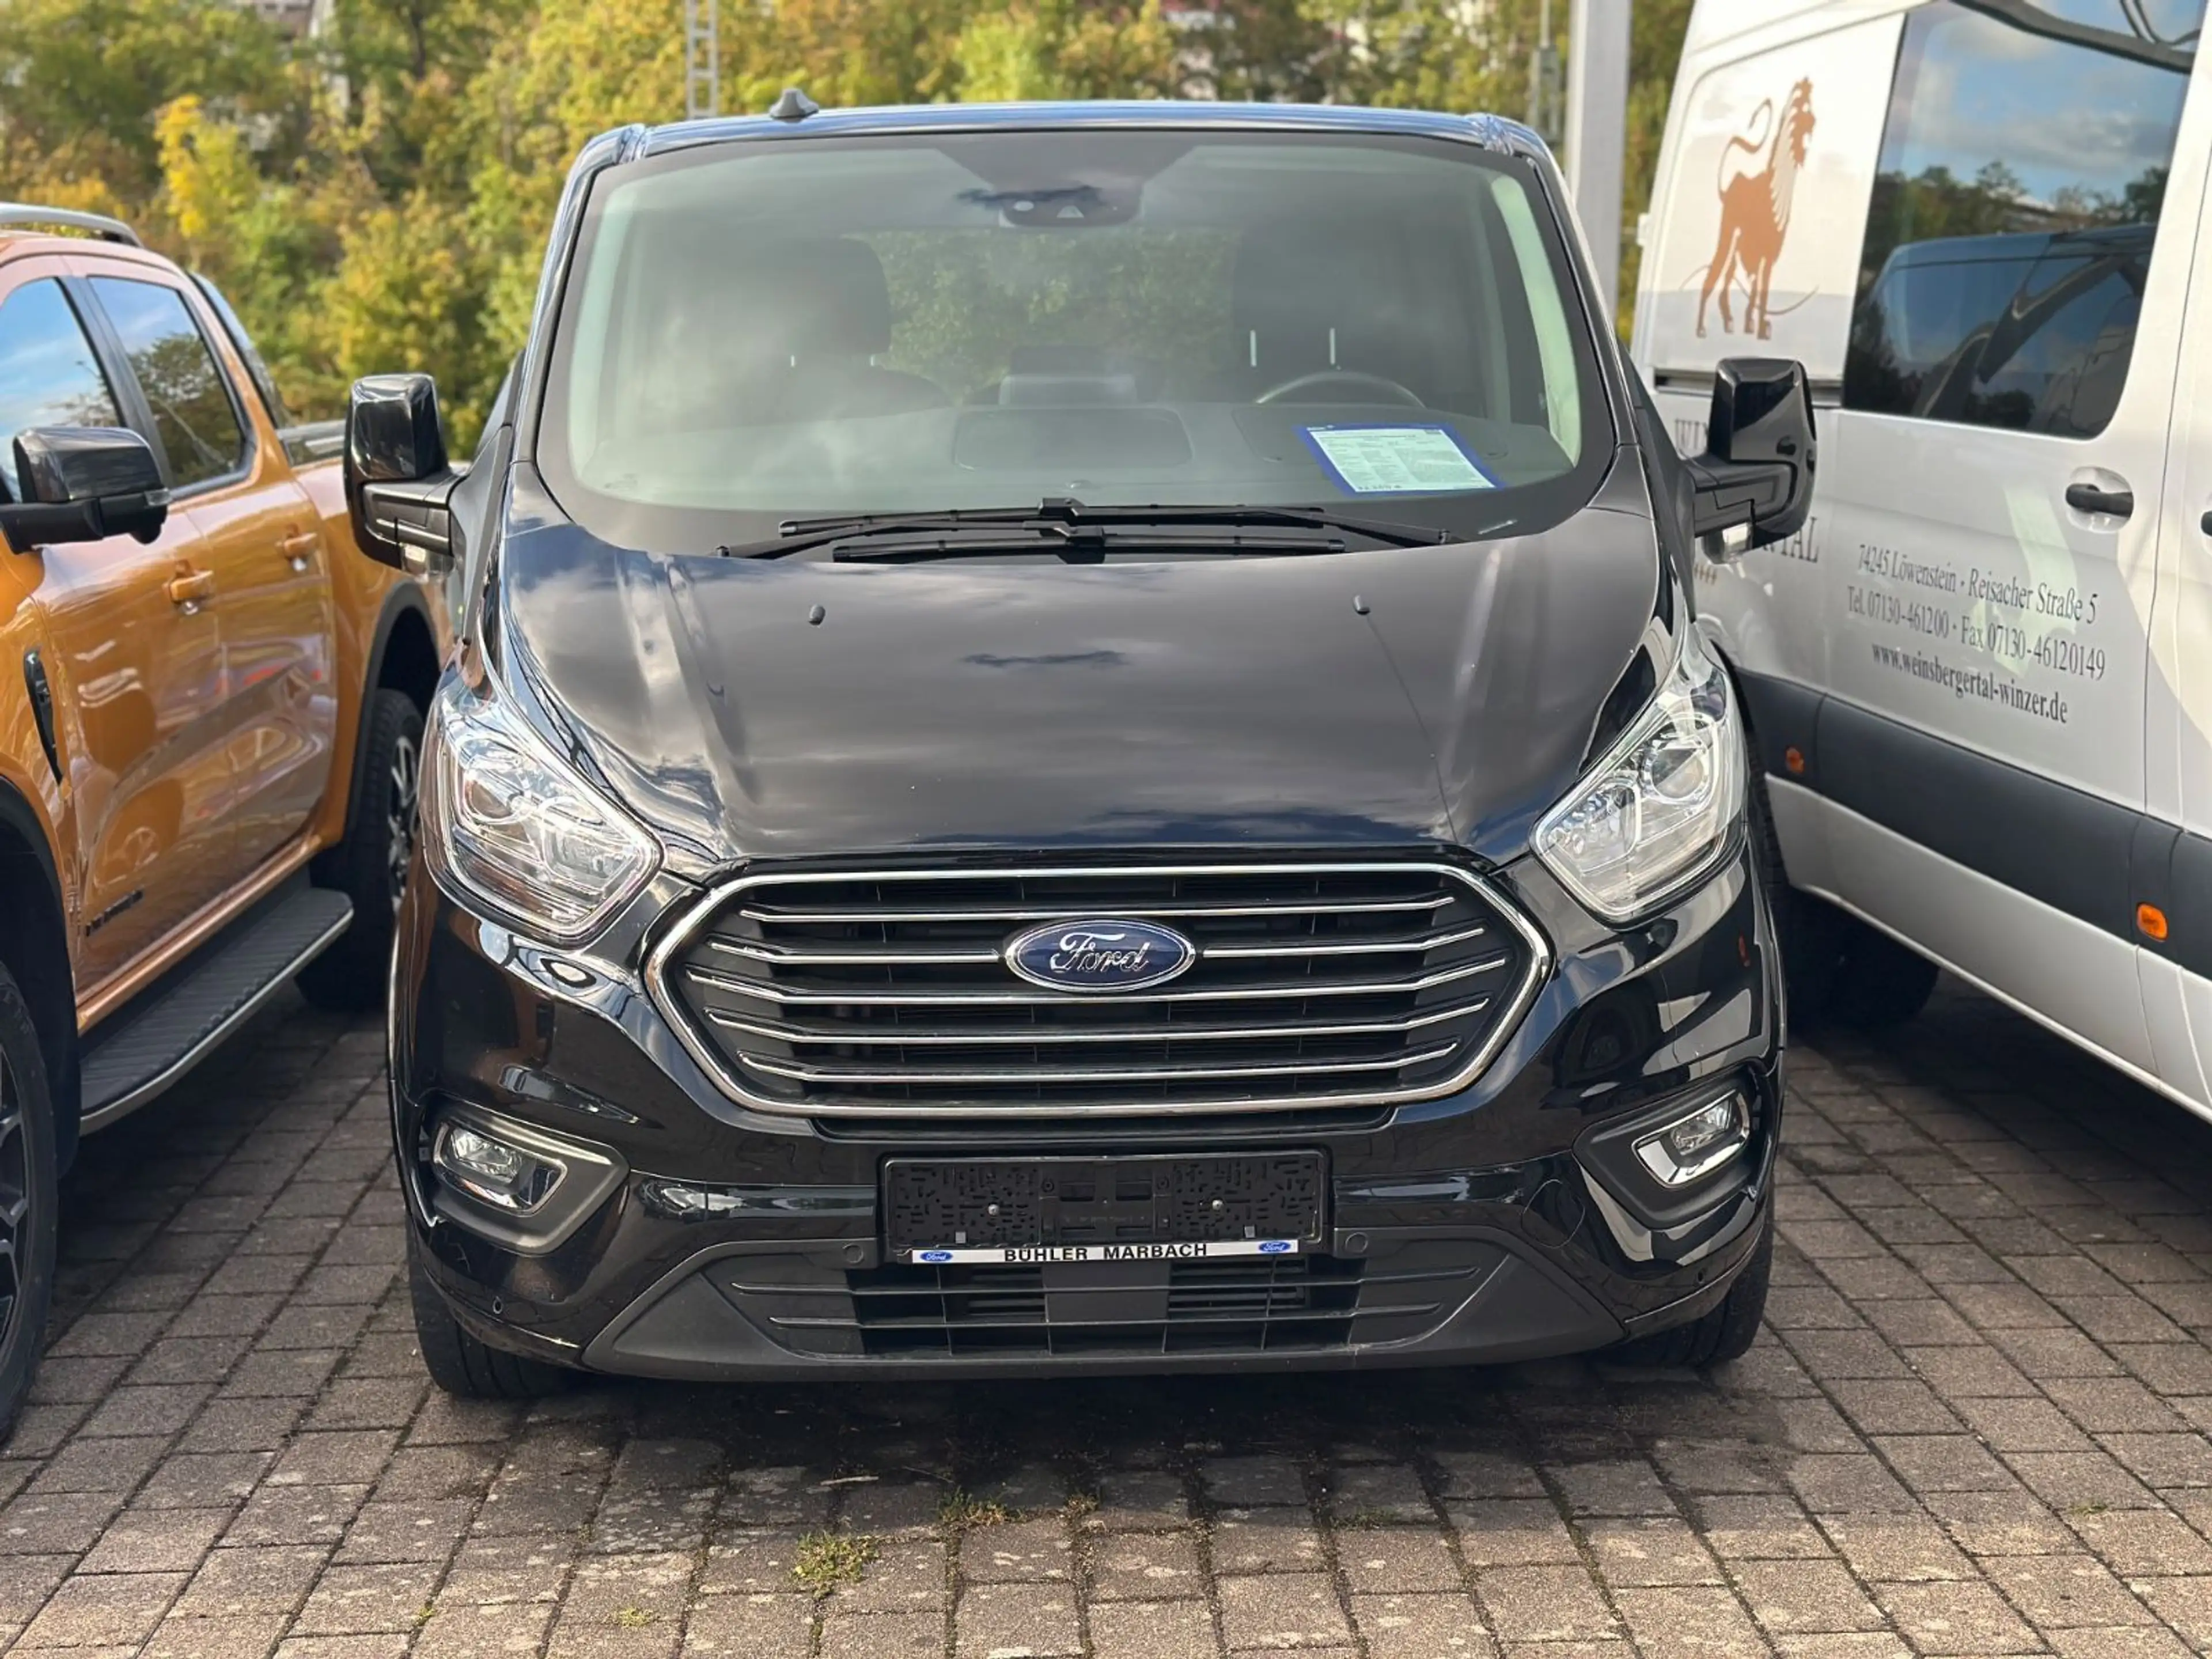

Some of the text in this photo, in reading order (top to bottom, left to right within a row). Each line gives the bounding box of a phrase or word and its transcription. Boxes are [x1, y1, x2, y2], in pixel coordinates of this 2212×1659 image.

[1858, 544, 2098, 624] 74245 Löwenstein Reisacher Straße 5
[1868, 590, 1949, 639] 07130-461200
[1961, 616, 1983, 649] Fax
[1988, 622, 2105, 681] 07130-46120149
[1872, 644, 2067, 724] www.weinsbergertal-winzer.de
[1050, 931, 1151, 973] Ford
[1104, 1244, 1207, 1260] MARBACH
